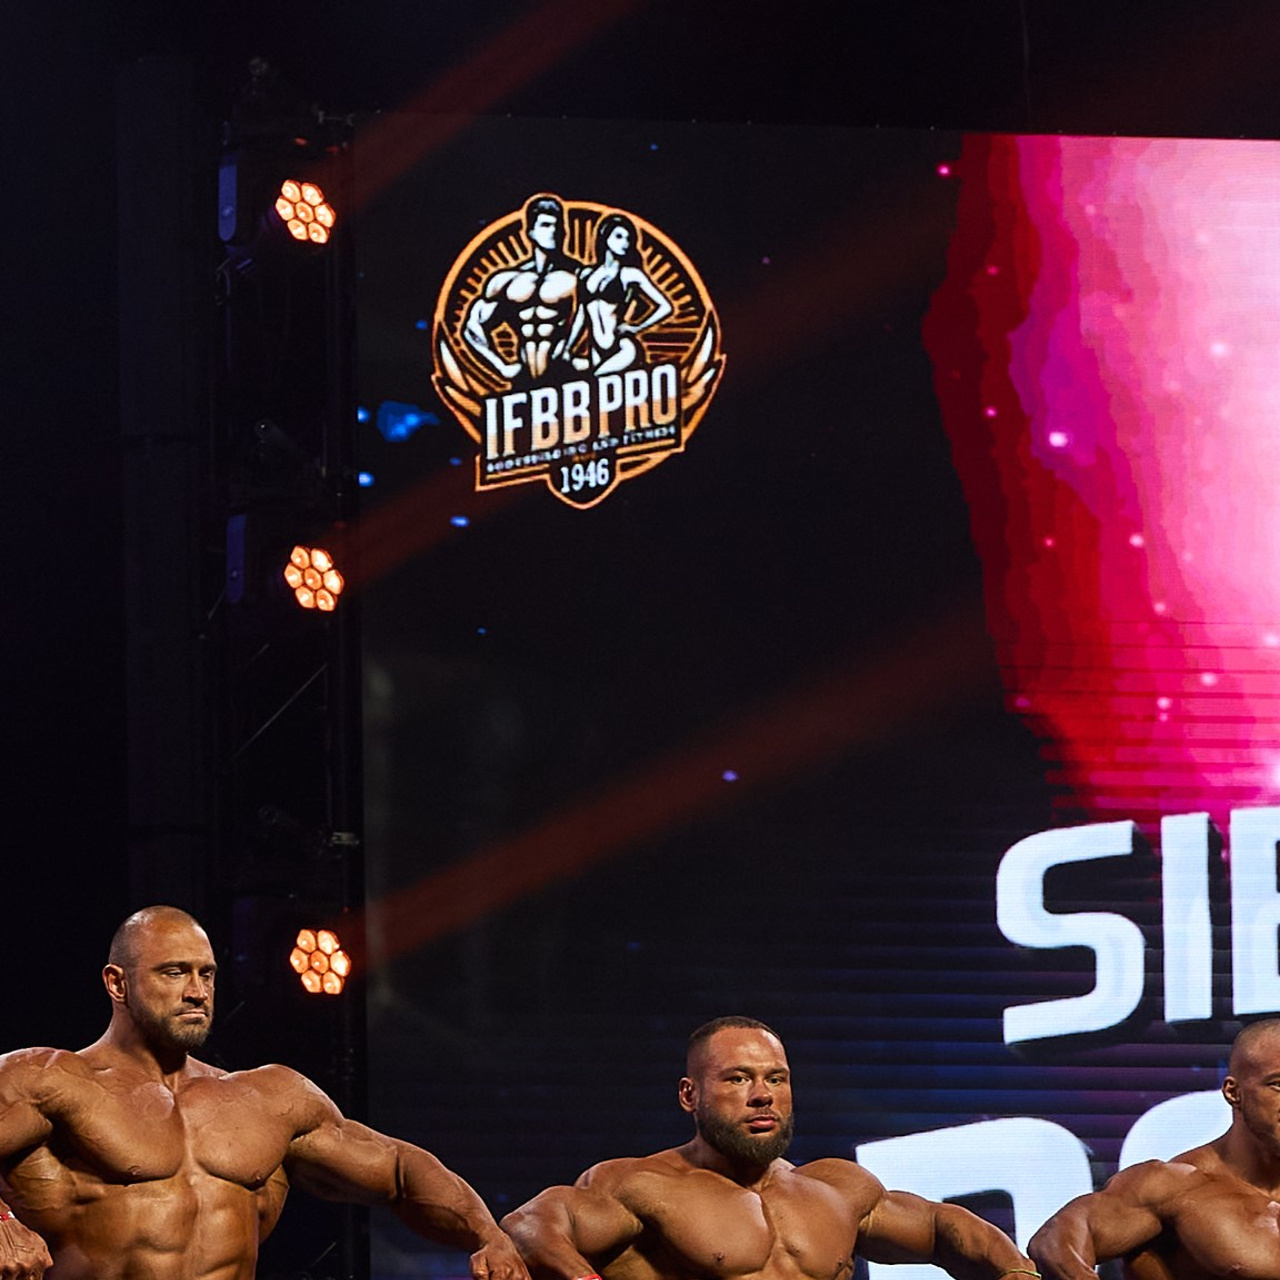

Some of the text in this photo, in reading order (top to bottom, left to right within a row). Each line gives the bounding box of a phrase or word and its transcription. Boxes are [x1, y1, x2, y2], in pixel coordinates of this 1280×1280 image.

[485, 364, 677, 460] IFBB PRO
[560, 458, 610, 493] 1946
